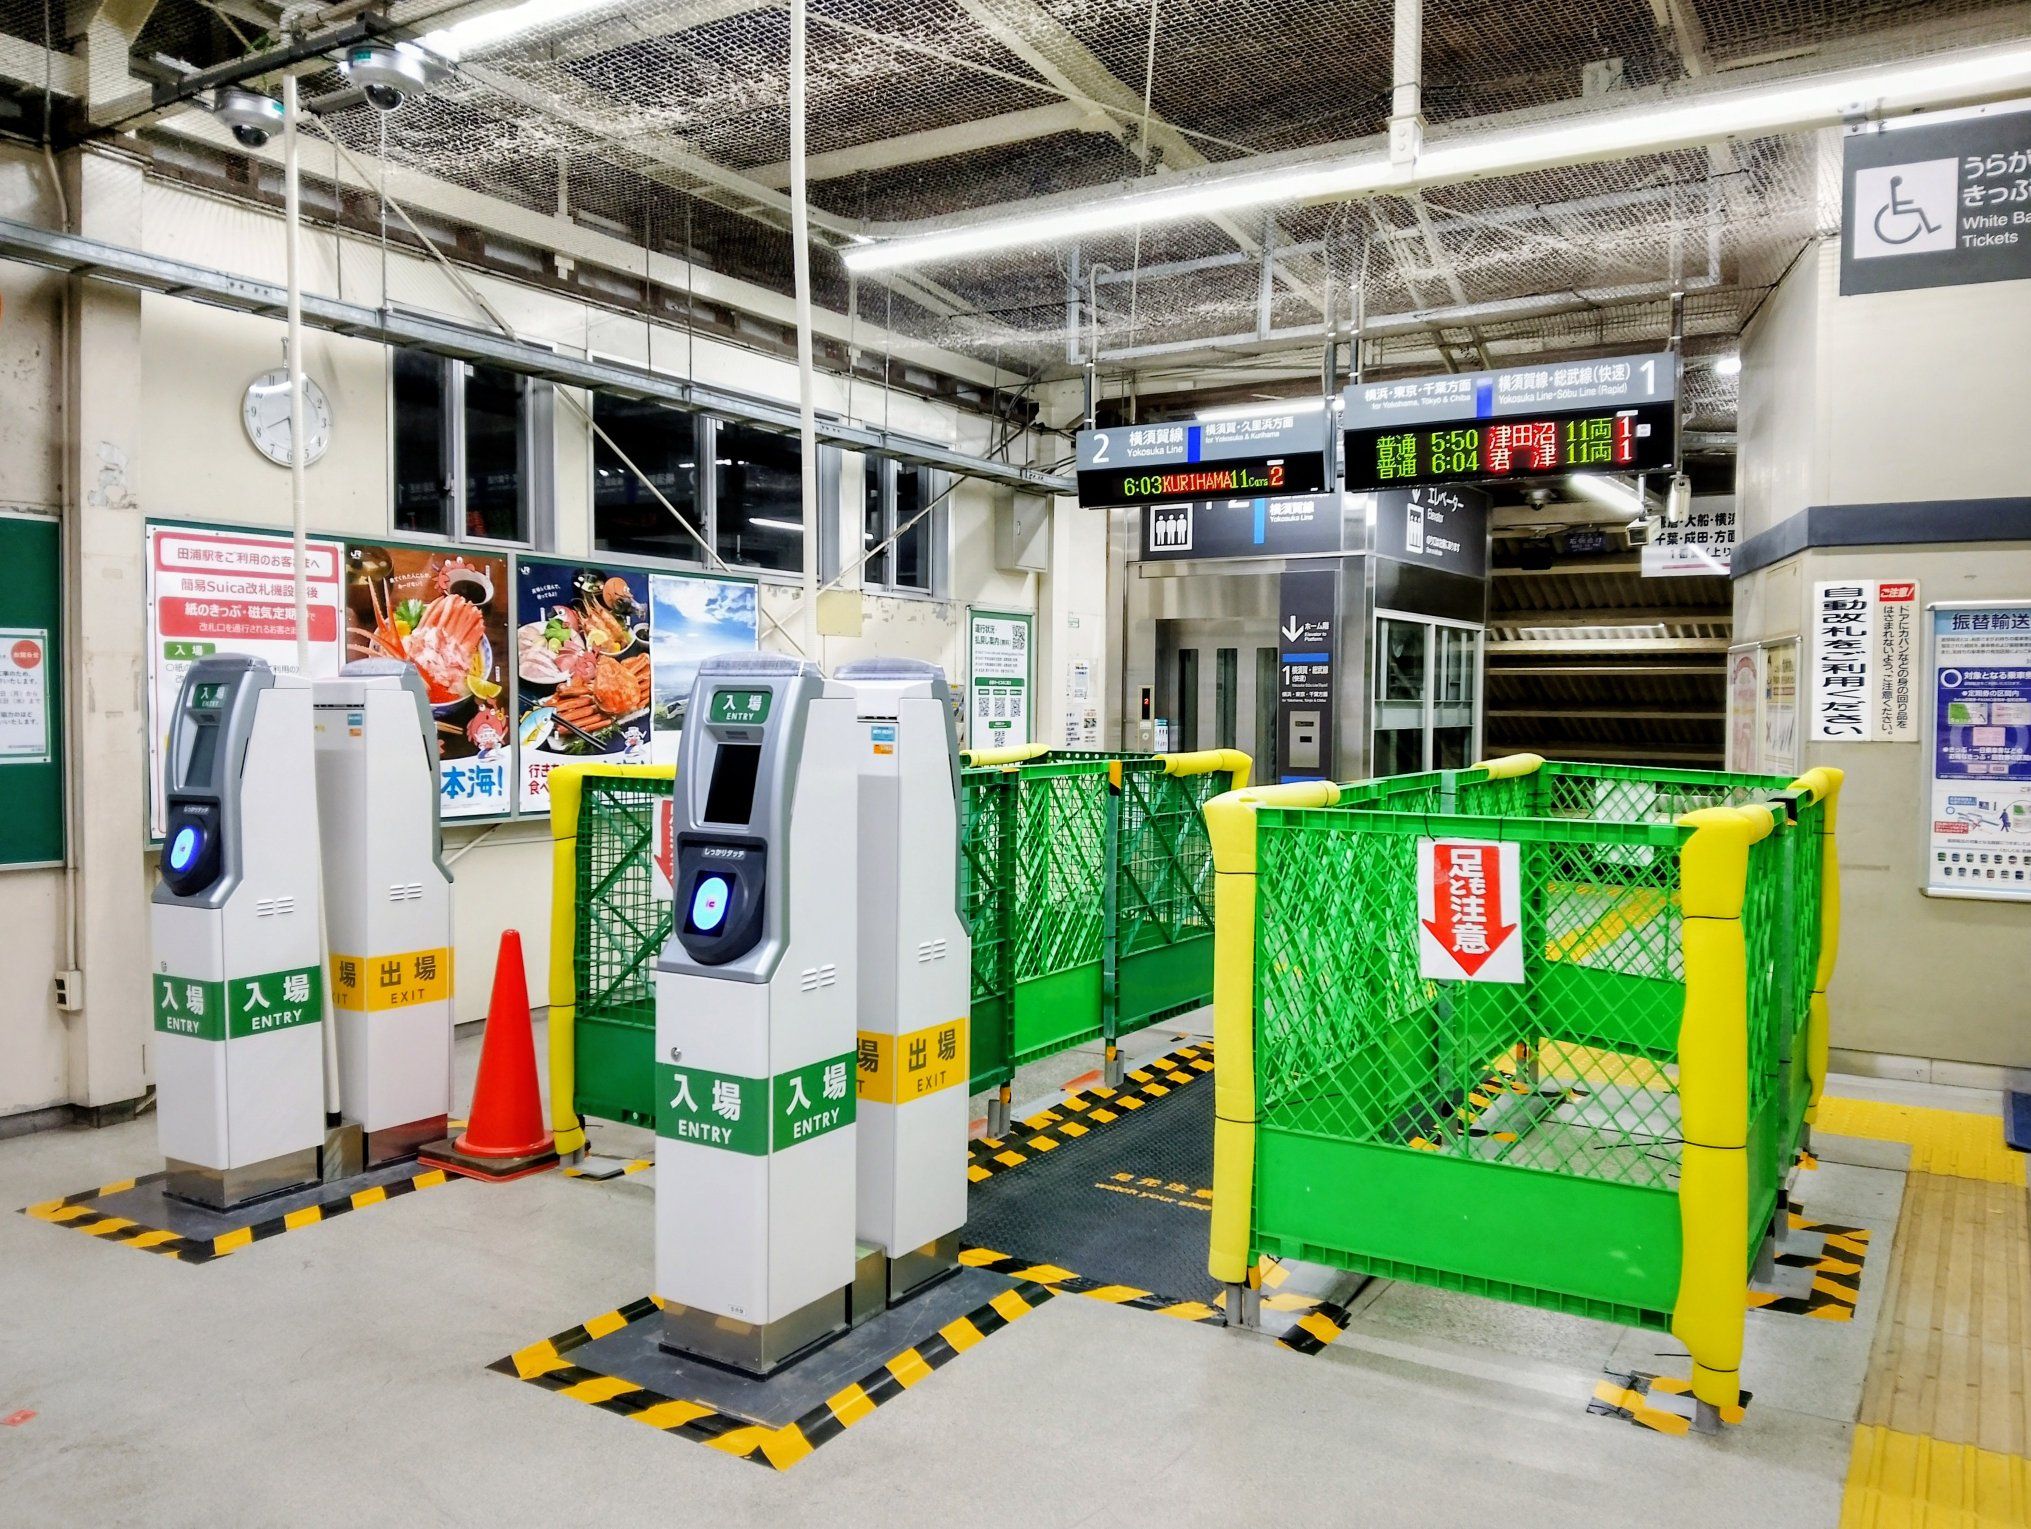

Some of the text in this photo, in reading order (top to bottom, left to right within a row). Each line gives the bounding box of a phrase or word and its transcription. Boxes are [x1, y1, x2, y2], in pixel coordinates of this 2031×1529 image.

[1963, 214, 2008, 230] White
[1962, 232, 2019, 248] Tickets
[1640, 359, 1655, 395] 1
[1365, 380, 1472, 402] 横浜・東京・千葉方面
[1498, 393, 1535, 404] Yokosuka
[1579, 385, 1597, 397] Line
[1598, 382, 1628, 396] (Rapid)
[1206, 416, 1294, 435] 横須賀・久里浜方面
[1129, 427, 1184, 447] 横須賀線
[1376, 415, 1632, 459] 普通 5:50 津田沼 11両 1
[1092, 433, 1110, 464] 2
[1127, 444, 1184, 458] Yokosuka Line
[1376, 454, 1417, 480] 普通
[1431, 452, 1480, 474] 6:04
[1565, 441, 1612, 465] 11両
[1618, 438, 1632, 461] 1
[1124, 474, 1162, 496] 6:03
[1162, 470, 1231, 493] KURIHAMA
[1270, 466, 1284, 487] 2
[351, 550, 361, 558] JR
[520, 566, 530, 574] JR
[181, 578, 318, 599] 簡易Suica改札機設後
[185, 602, 316, 621] 紙のきっぷ・磁気定期で
[1952, 613, 2030, 631] 振替輸送
[1821, 587, 1867, 735] 自動改札をご利用ください
[723, 694, 763, 711] 入場
[726, 712, 754, 721] ENTRY
[704, 848, 744, 859] しっかりタッチ
[380, 954, 436, 988] 出場
[161, 980, 204, 1015] 入場
[243, 974, 310, 1012] 入場
[391, 988, 425, 1004] EXIT
[167, 1016, 199, 1034] ENTRY
[252, 1008, 302, 1030] ENTRY
[908, 1028, 956, 1073] 出場
[785, 1061, 847, 1115] 入場
[917, 1070, 946, 1092] EXIT
[670, 1073, 741, 1121] 入場
[678, 1119, 732, 1145] ENTRY
[793, 1107, 840, 1139] ENTRY
